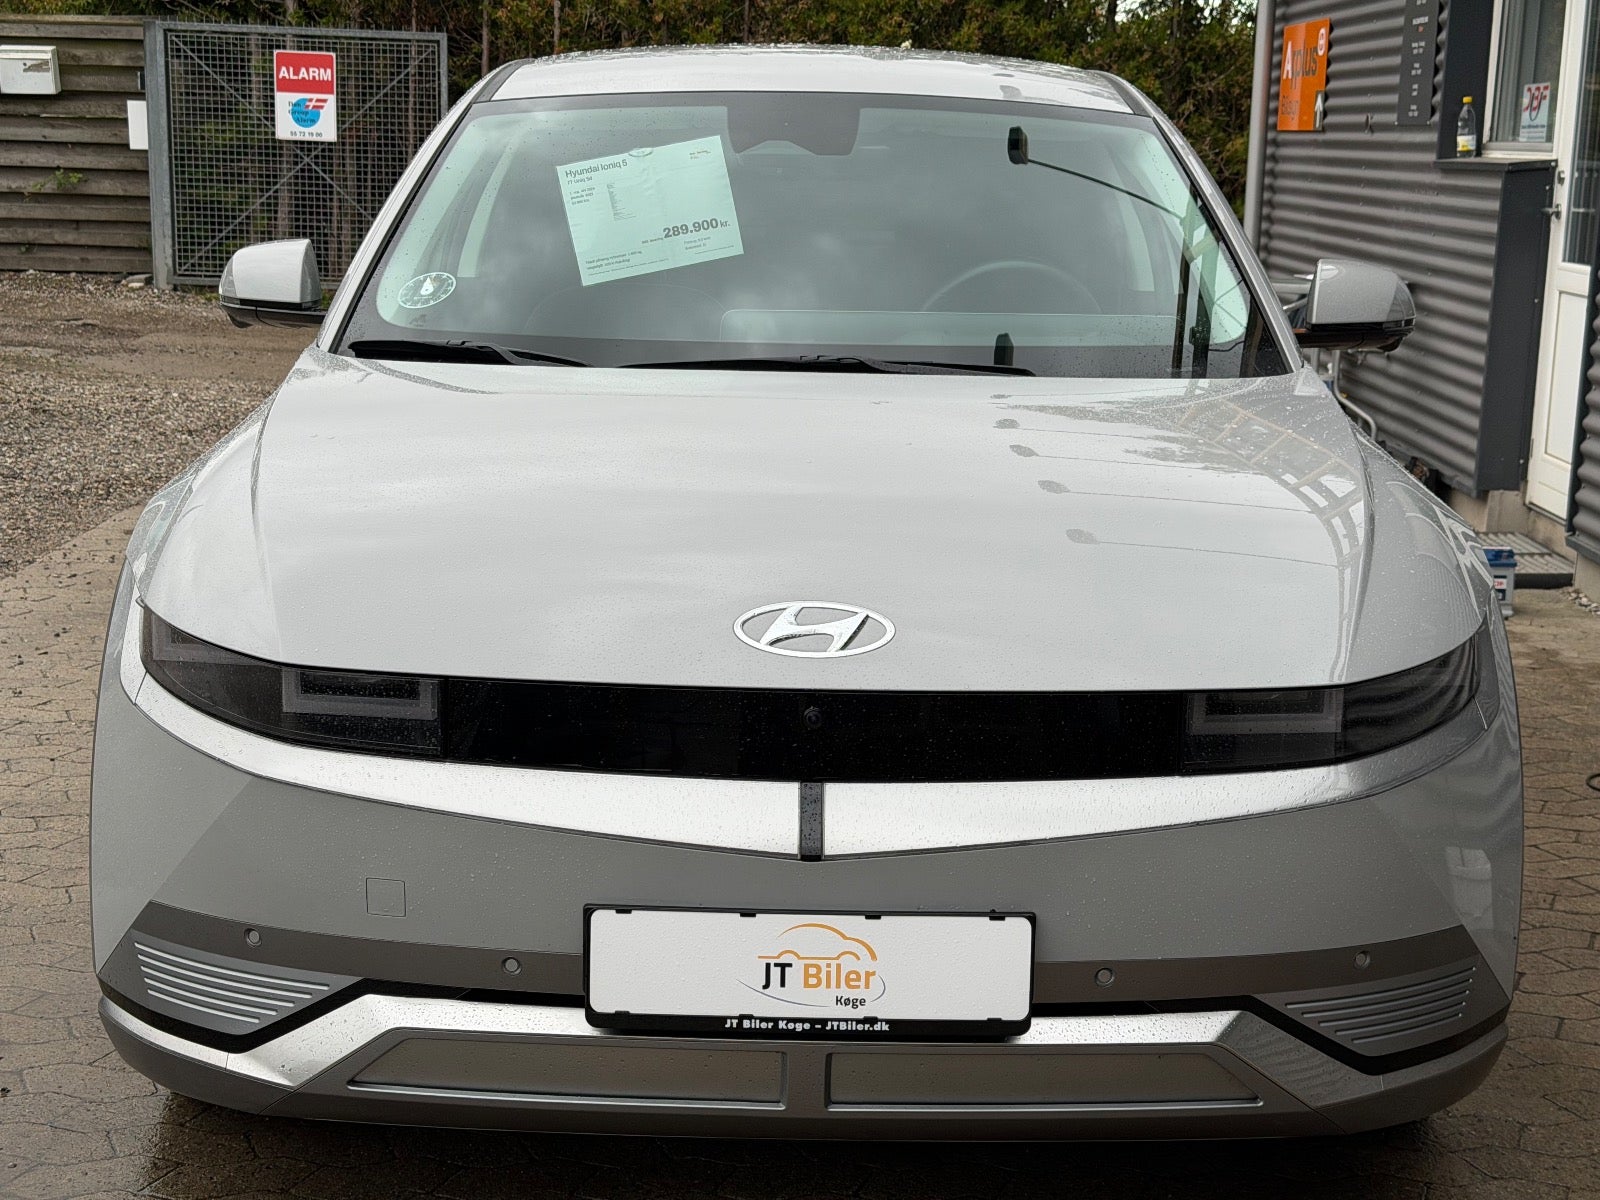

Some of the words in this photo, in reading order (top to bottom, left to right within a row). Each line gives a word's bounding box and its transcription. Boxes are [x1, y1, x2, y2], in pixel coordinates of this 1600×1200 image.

[279, 66, 332, 81] ALARM
[565, 164, 600, 179] Hyundai
[600, 161, 622, 172] Ioniq
[621, 159, 628, 167] 5
[662, 217, 719, 239] 289.900
[719, 219, 731, 228] kr.
[762, 962, 793, 990] JT
[803, 962, 876, 990] Biler
[835, 995, 867, 1009] Køge
[724, 1018, 740, 1029] JT
[742, 1018, 774, 1030] Biler
[778, 1019, 811, 1032] Køge
[825, 1020, 890, 1032] JTBiler.dk
